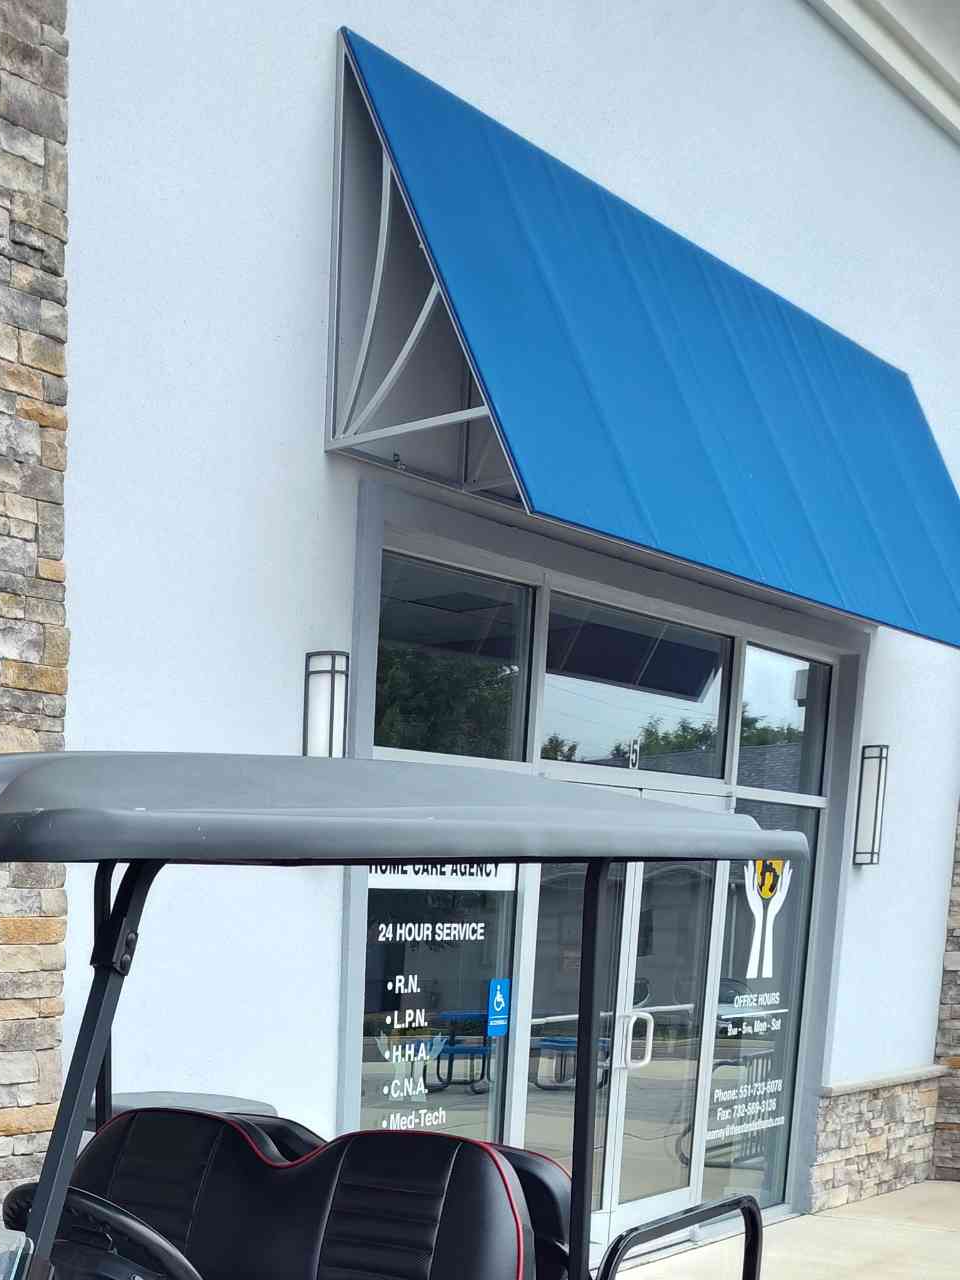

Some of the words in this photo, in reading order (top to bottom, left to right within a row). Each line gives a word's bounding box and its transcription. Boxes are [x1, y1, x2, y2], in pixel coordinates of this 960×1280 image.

[369, 864, 408, 875] HOME
[412, 864, 446, 876] CARE
[450, 864, 499, 877] AGENCY
[378, 923, 393, 942] 24
[396, 922, 432, 942] HOUR
[435, 922, 485, 941] SERVICE
[395, 974, 421, 994] R.N.
[734, 994, 757, 1008] OFFICE
[758, 992, 780, 1006] HOURS
[393, 1008, 428, 1029] L.P.N.
[392, 1042, 430, 1064] H.H.A.
[391, 1076, 429, 1097] C.N.A.
[714, 1088, 738, 1103] Phone:
[389, 1107, 447, 1131] Med-Tech
